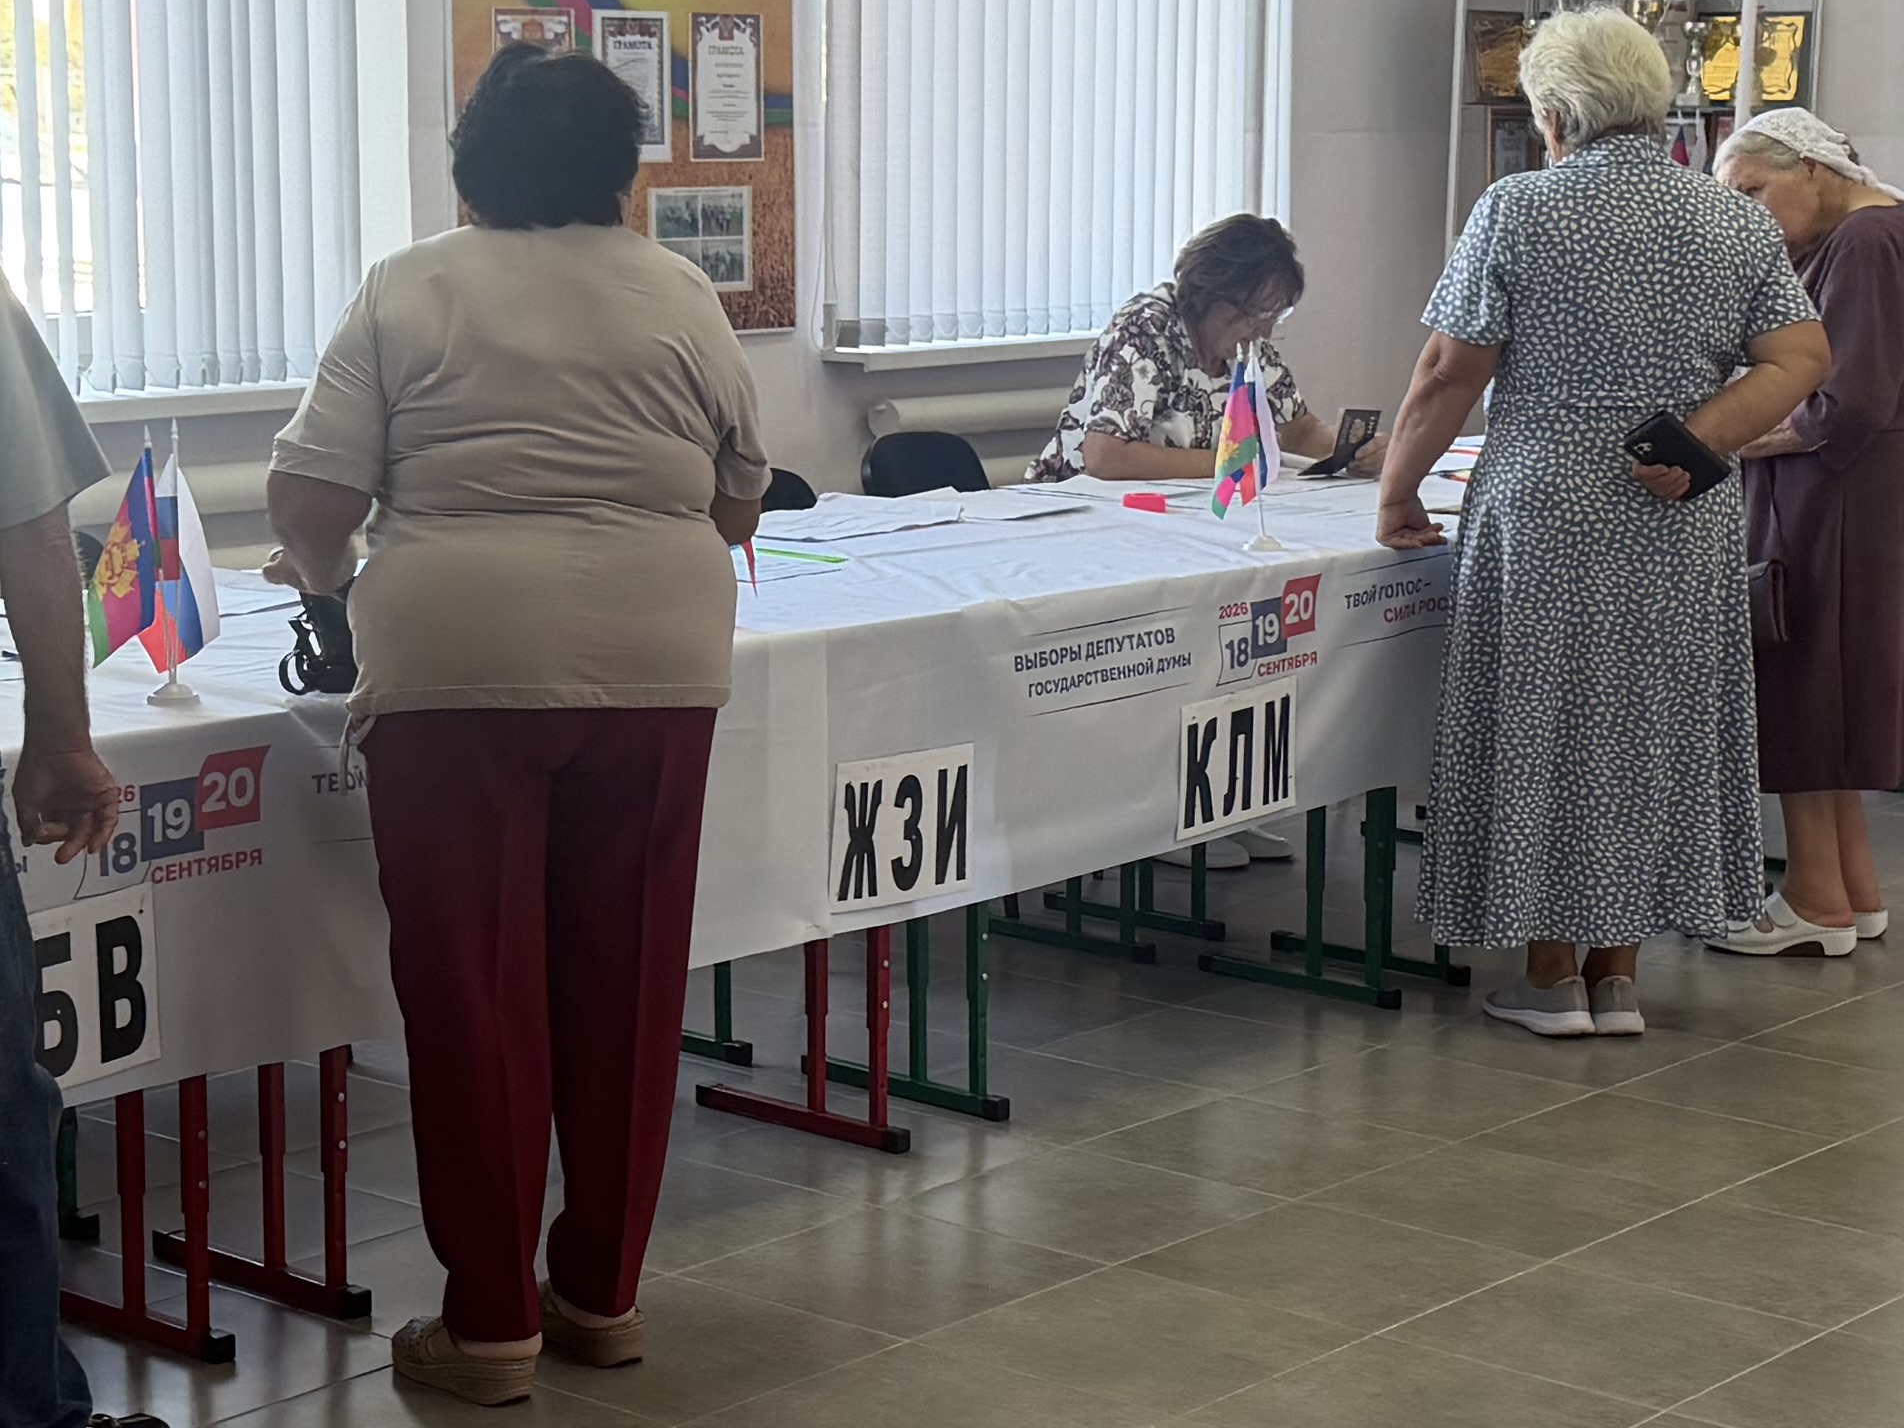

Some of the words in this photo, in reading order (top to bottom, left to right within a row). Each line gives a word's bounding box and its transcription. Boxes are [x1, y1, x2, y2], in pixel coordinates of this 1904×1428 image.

[1218, 601, 1248, 620] 2026
[1344, 584, 1377, 609] ТВОЙ
[1014, 643, 1082, 673] ВЫБОРЫ
[1084, 626, 1176, 662] ДЕПУТАТОВ
[1224, 636, 1250, 670] 18
[1254, 612, 1279, 646] 19
[1284, 589, 1315, 625] 20
[1028, 659, 1155, 699] ГОСУДАРСТВЕННОЙ
[1155, 652, 1192, 676] ДУМЫ
[1256, 650, 1318, 678] СЕНТЯБРЯ
[1183, 693, 1291, 830] КЛМ
[146, 797, 192, 844] 19
[200, 764, 256, 814] 20
[837, 764, 969, 903] ЖЗИ
[151, 847, 263, 886] СЕНТЯБРЯ
